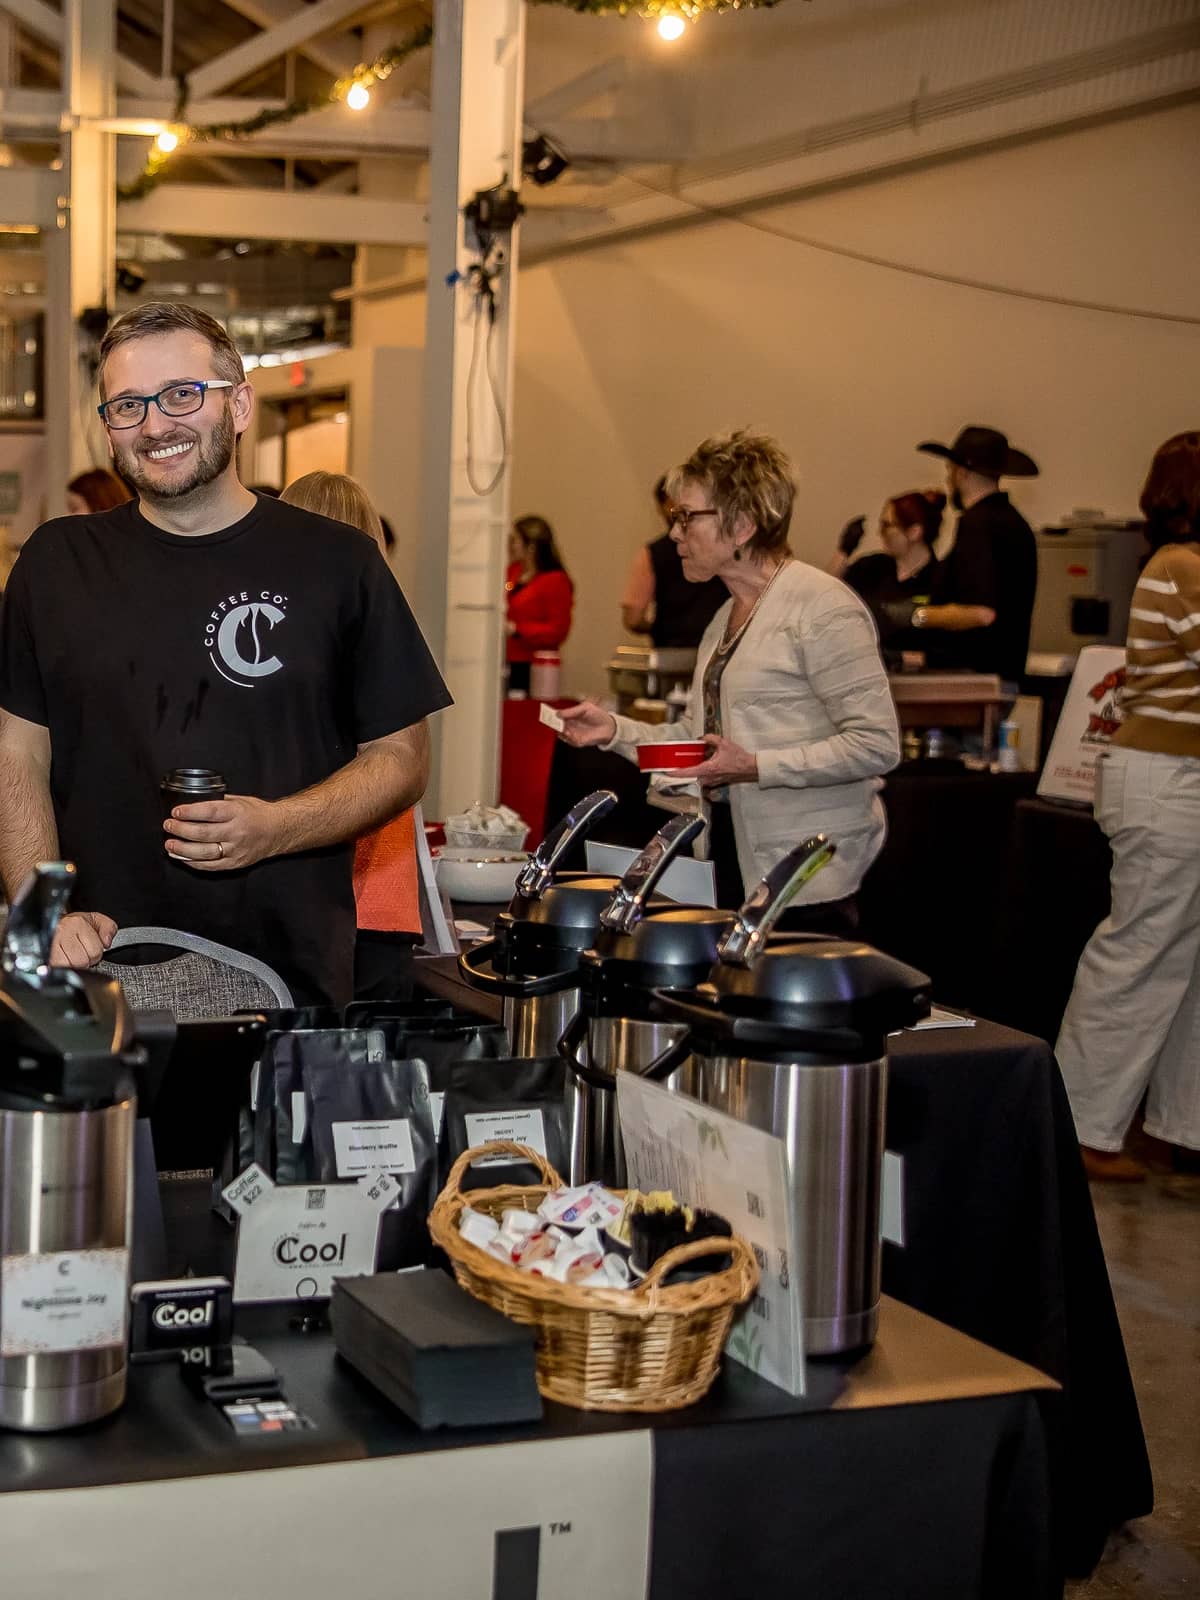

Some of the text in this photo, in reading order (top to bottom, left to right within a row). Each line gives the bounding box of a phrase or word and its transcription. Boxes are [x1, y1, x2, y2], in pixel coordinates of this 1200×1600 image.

[204, 591, 249, 647] COFFEE
[348, 1144, 377, 1152] Blueberry
[227, 1170, 260, 1200] Coffee
[242, 1184, 263, 1205] $22
[276, 1233, 349, 1265] Cool
[154, 1300, 215, 1327] Cool
